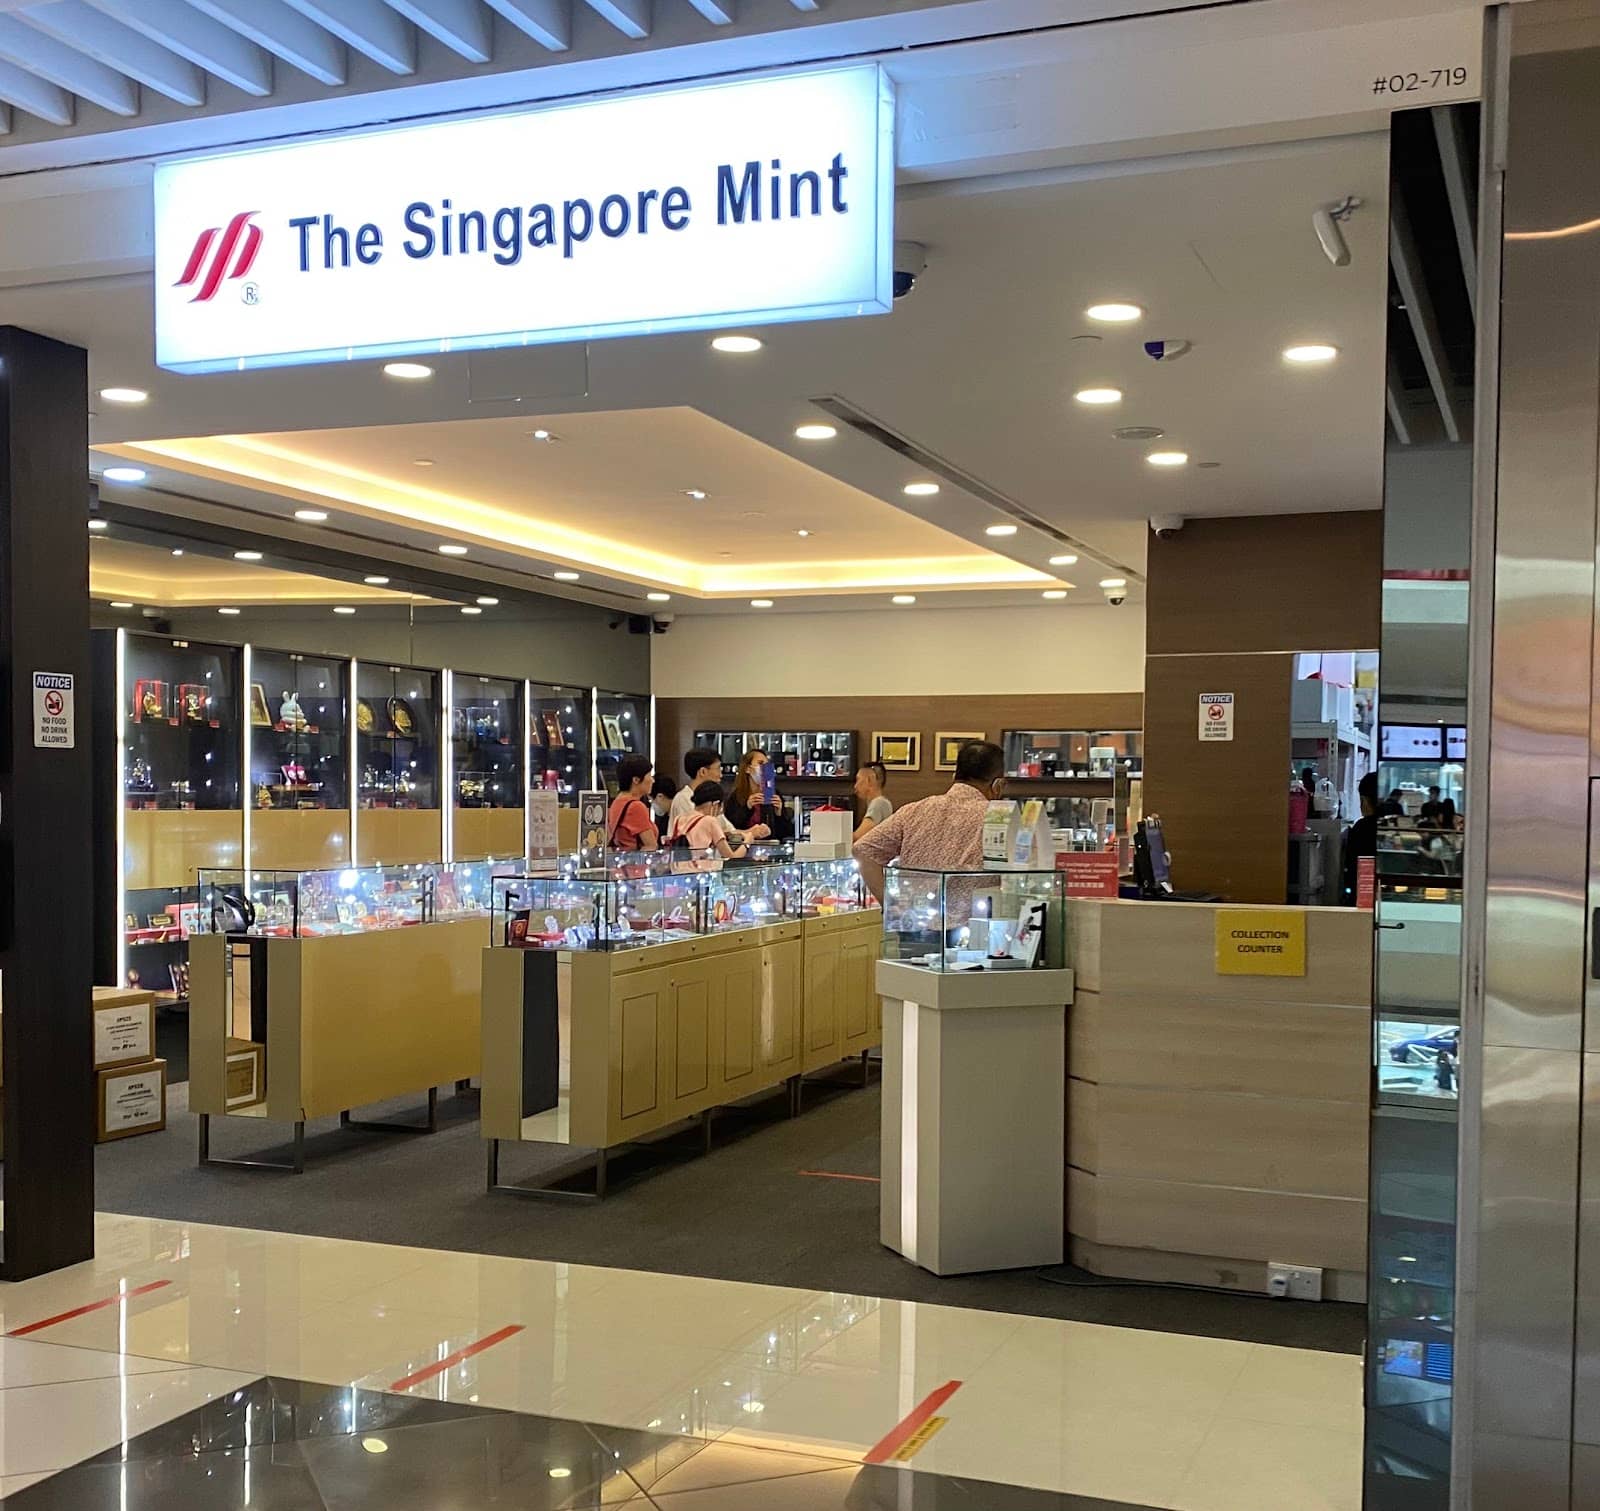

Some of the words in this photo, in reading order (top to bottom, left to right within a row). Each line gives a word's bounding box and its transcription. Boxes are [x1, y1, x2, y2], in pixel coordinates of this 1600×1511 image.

[1372, 67, 1467, 95] #02-719
[289, 213, 384, 273] The
[402, 185, 692, 266] Singapore
[717, 152, 849, 226] Mint
[36, 676, 70, 688] NOTICE
[41, 735, 68, 743] ALLOWED
[1231, 930, 1289, 938] COLLECTION
[1238, 945, 1283, 953] COUNTER
